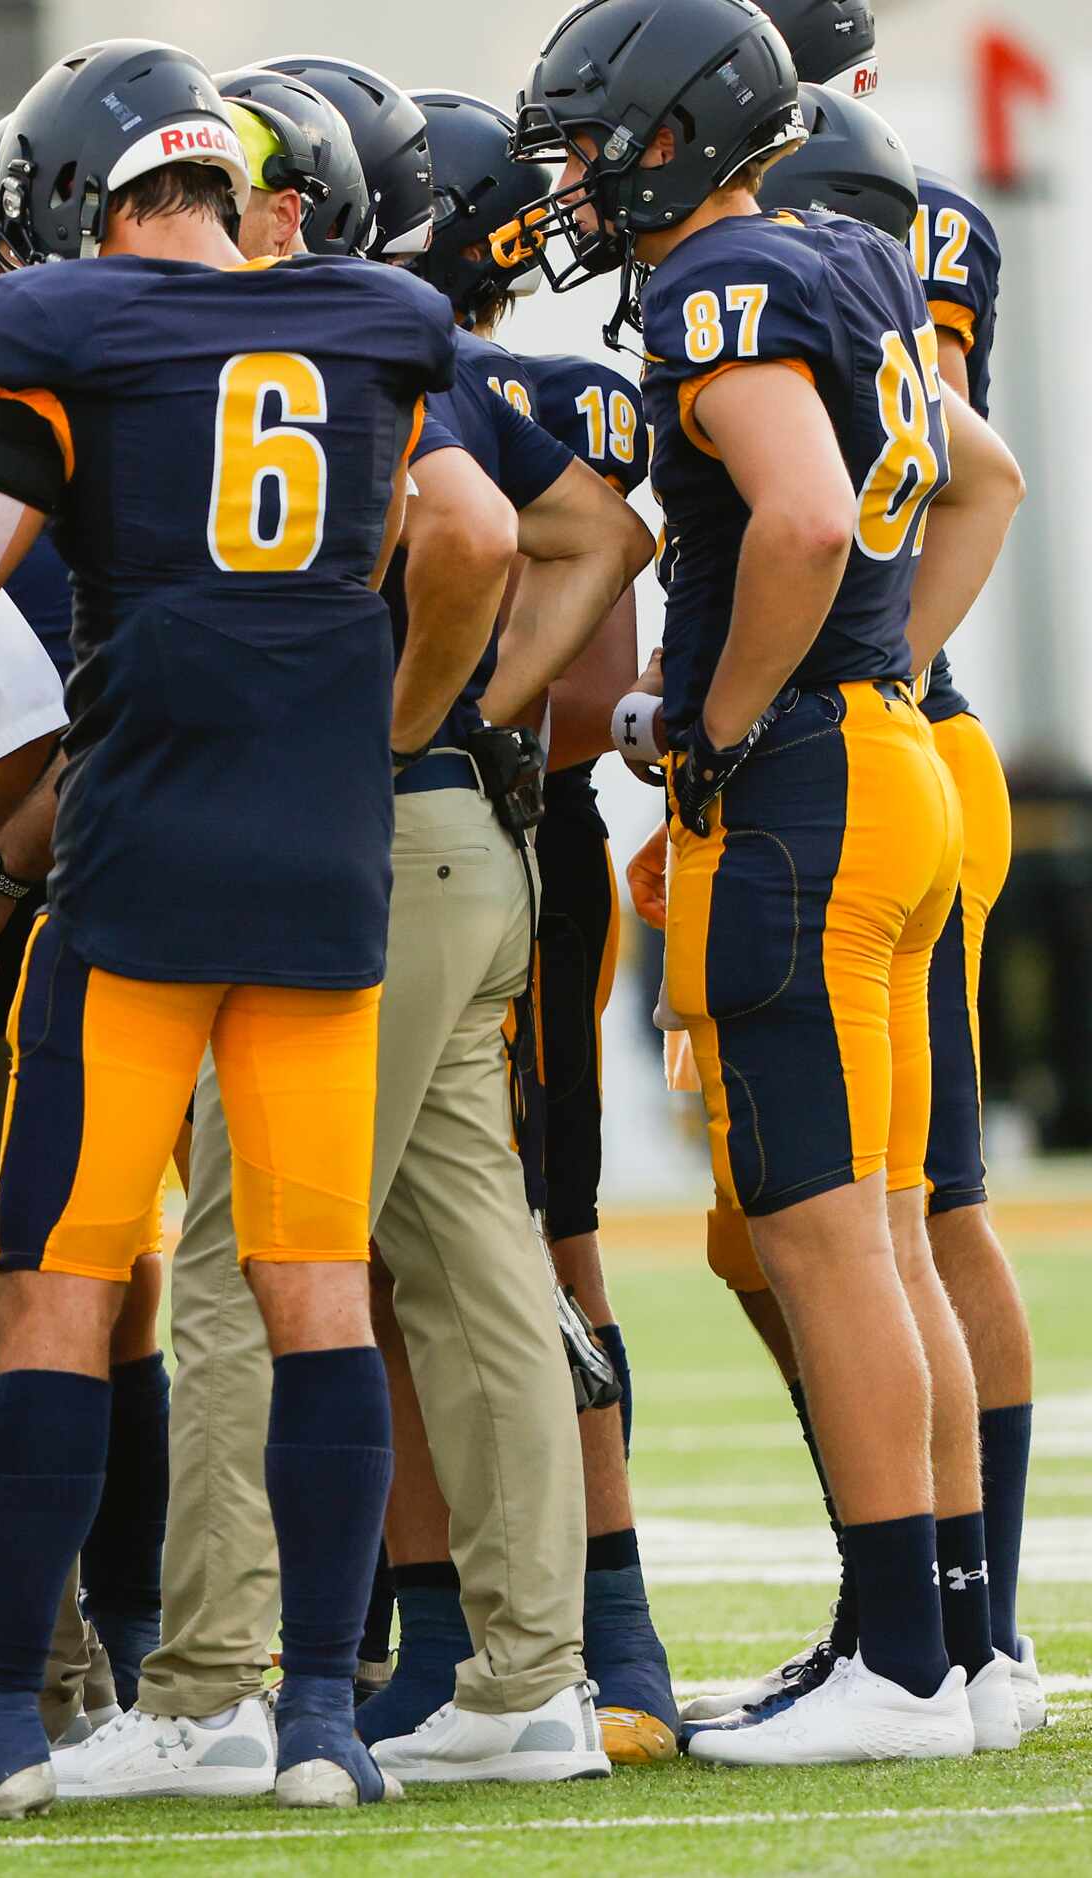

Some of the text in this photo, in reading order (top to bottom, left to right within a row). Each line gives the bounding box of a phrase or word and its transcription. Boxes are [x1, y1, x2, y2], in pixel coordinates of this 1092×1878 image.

[909, 204, 971, 286] 12
[683, 284, 769, 363] 87
[207, 351, 328, 572] 6
[574, 385, 637, 464] 19
